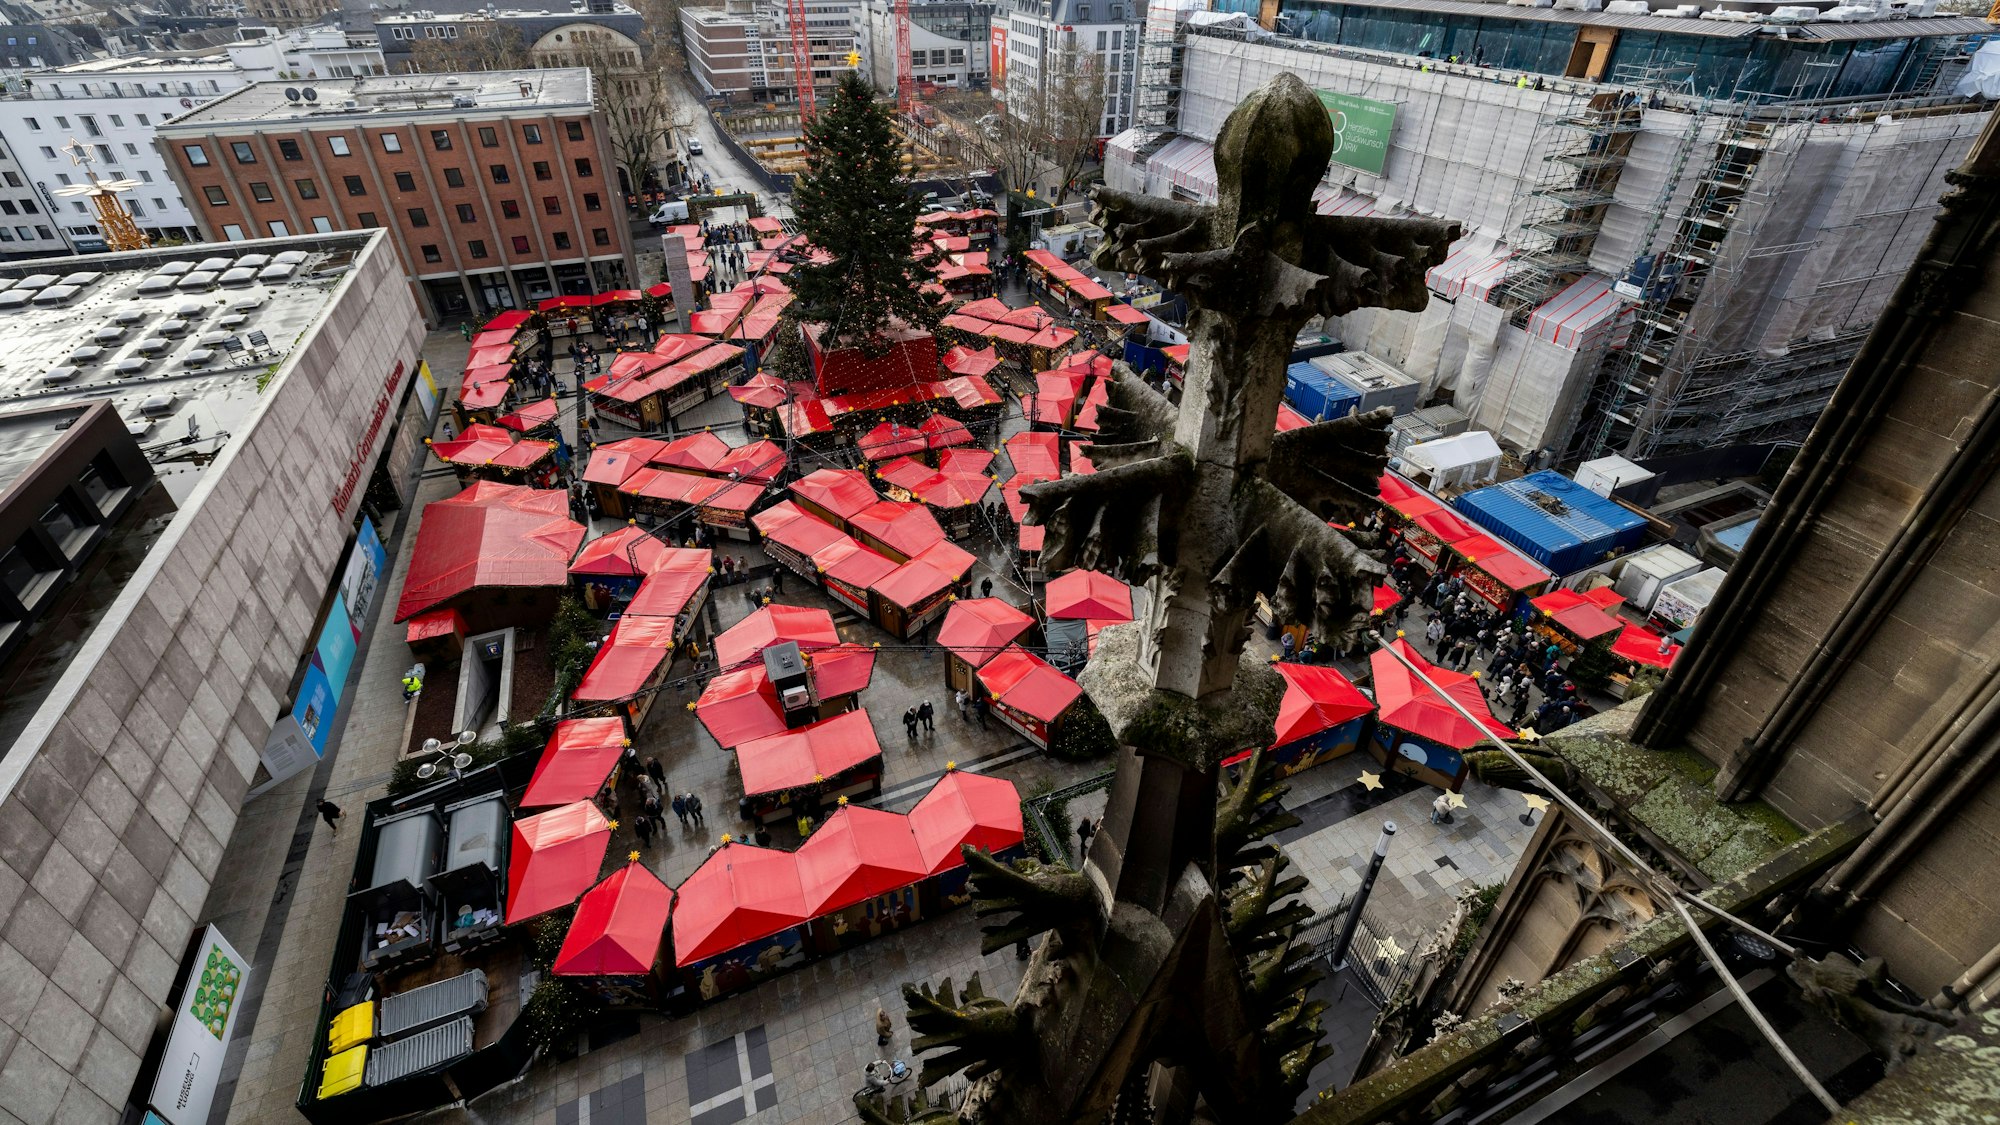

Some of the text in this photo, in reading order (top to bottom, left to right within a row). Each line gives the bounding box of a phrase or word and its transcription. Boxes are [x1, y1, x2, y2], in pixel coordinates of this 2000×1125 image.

[1347, 123, 1378, 136] Herzlichen
[1343, 142, 1358, 153] NRW
[1345, 132, 1384, 149] Glückwunsch
[176, 1069, 191, 1110] MUSEUM
[181, 1073, 195, 1108] LUDWIG
